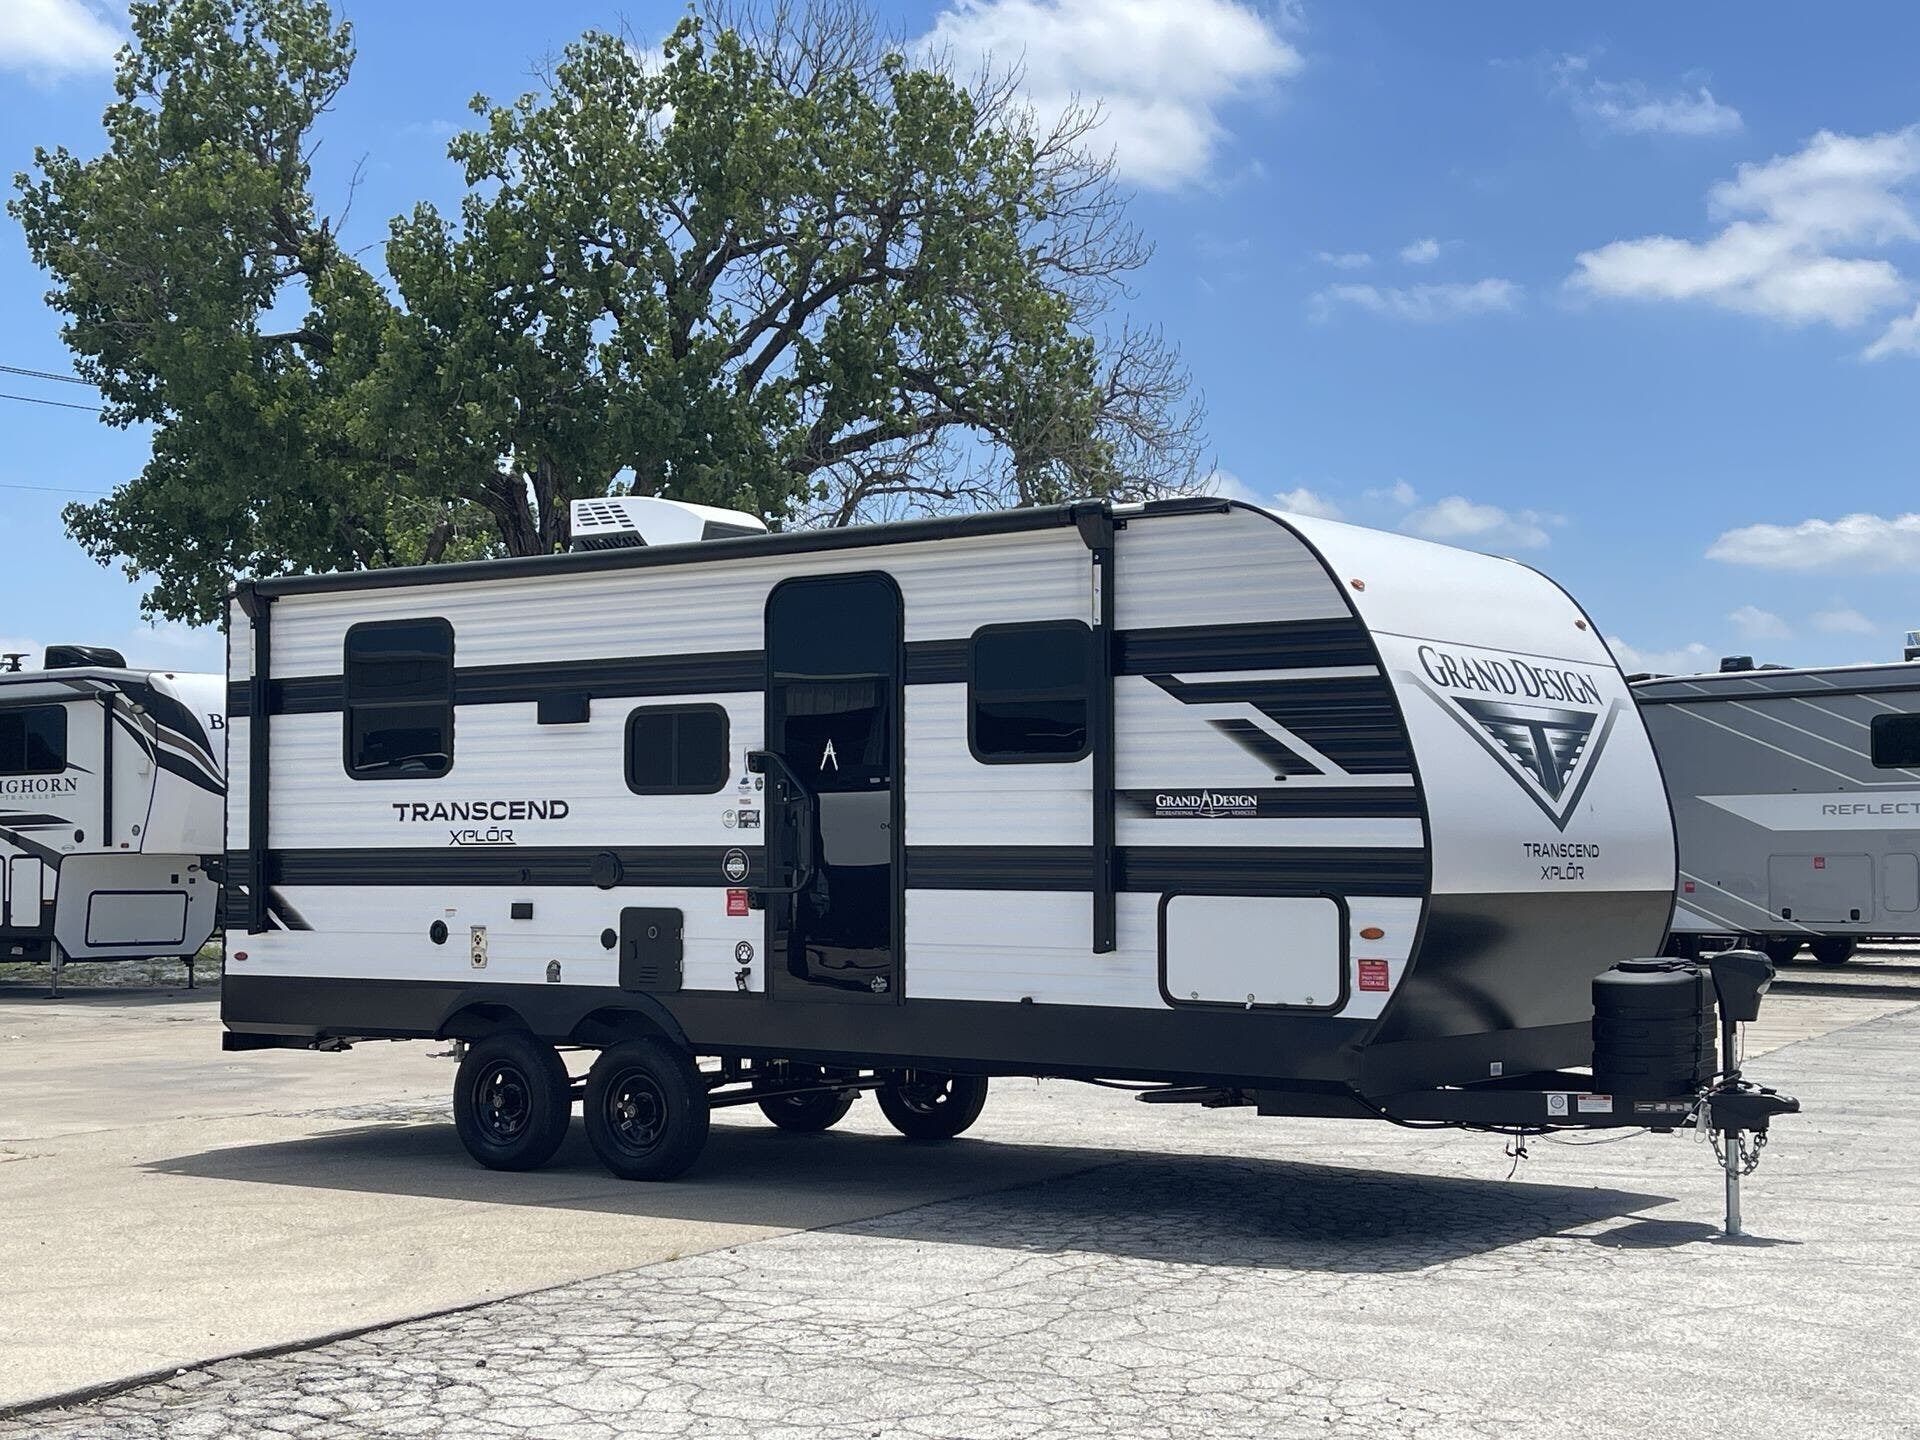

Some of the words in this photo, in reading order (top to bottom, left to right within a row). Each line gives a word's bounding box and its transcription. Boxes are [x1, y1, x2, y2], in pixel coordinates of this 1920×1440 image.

[1417, 644, 1517, 695] GRAND
[1509, 658, 1604, 706] DESIGN
[207, 713, 225, 730] B
[1155, 794, 1201, 807] GRAND
[1212, 794, 1258, 807] DESIGN
[392, 799, 570, 822] TRANSCEND
[1822, 803, 1920, 816] REFLECT
[1523, 843, 1600, 859] TRANSCEND
